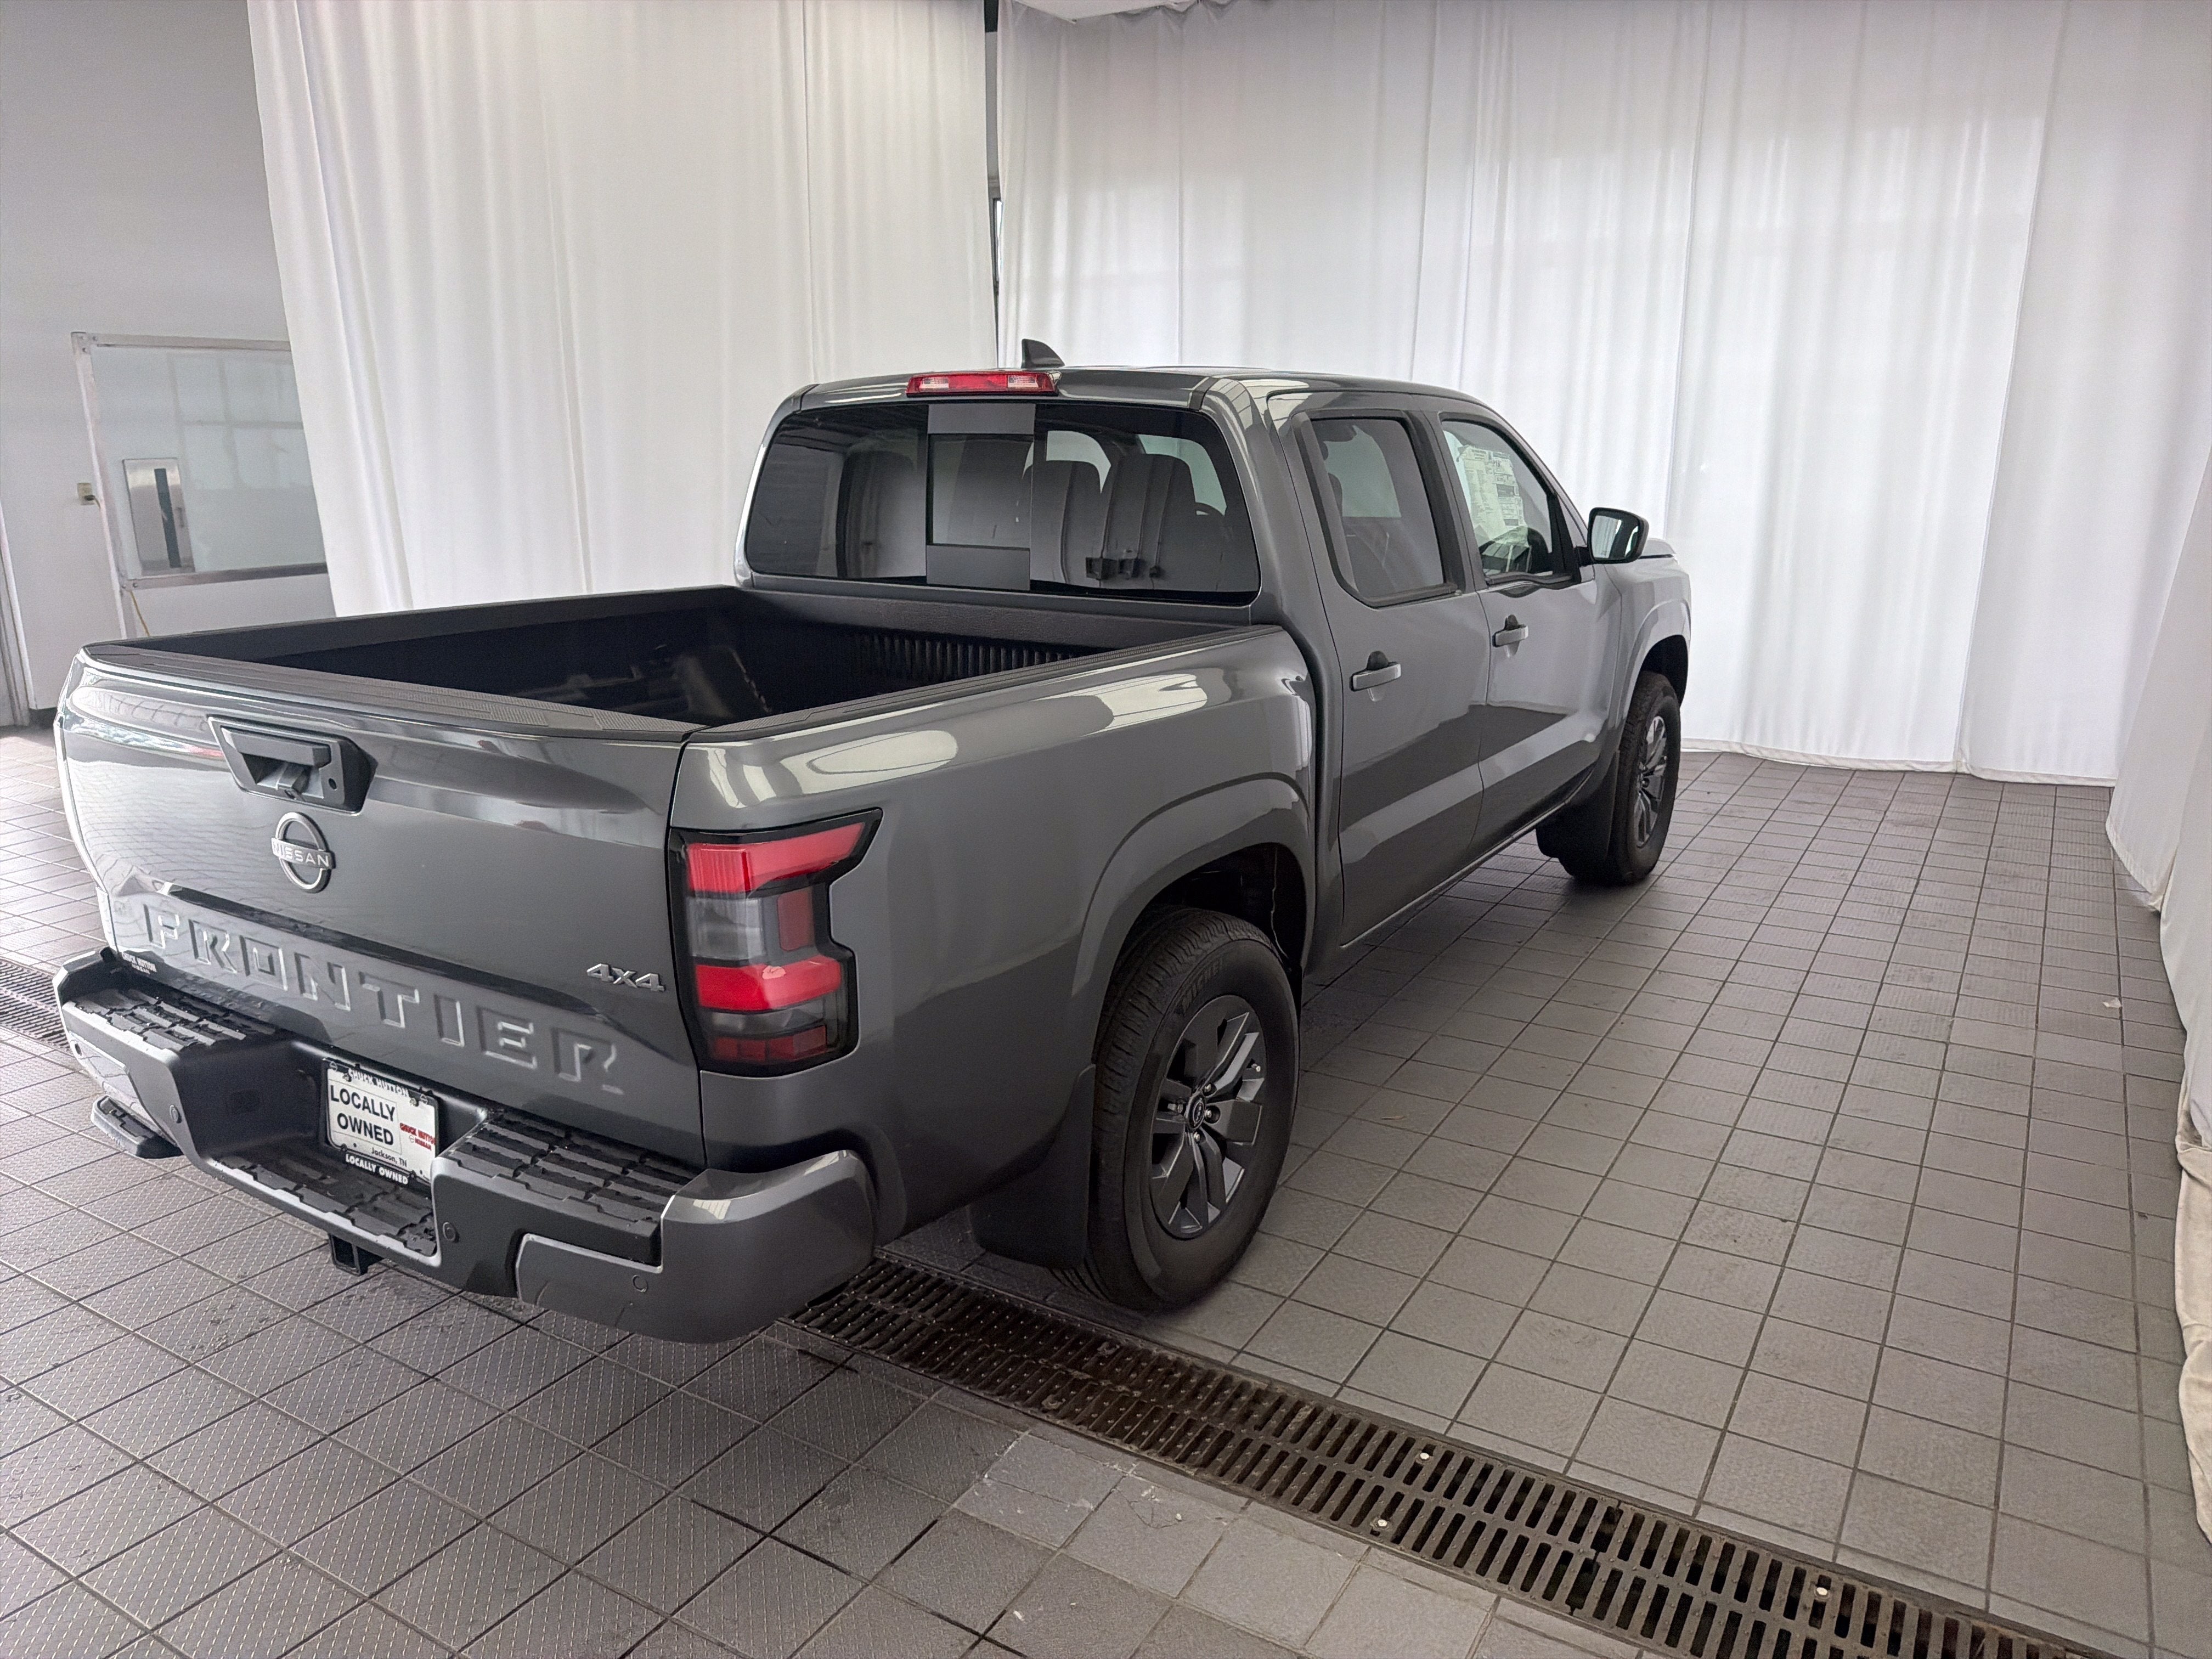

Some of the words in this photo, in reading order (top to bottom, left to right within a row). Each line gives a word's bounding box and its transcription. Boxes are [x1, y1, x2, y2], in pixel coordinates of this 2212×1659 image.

[272, 838, 329, 867] NISSAN
[144, 903, 624, 1094] FRONTIER
[348, 1068, 374, 1086] CHUCK
[376, 1077, 409, 1098] HUTTON
[330, 1085, 396, 1122] LOCALLY
[337, 1113, 393, 1146] OWNED
[346, 1153, 376, 1173] LOCALLY
[379, 1166, 408, 1184] OWNED
[371, 1147, 398, 1165] Jackson,
[399, 1157, 407, 1167] TN
